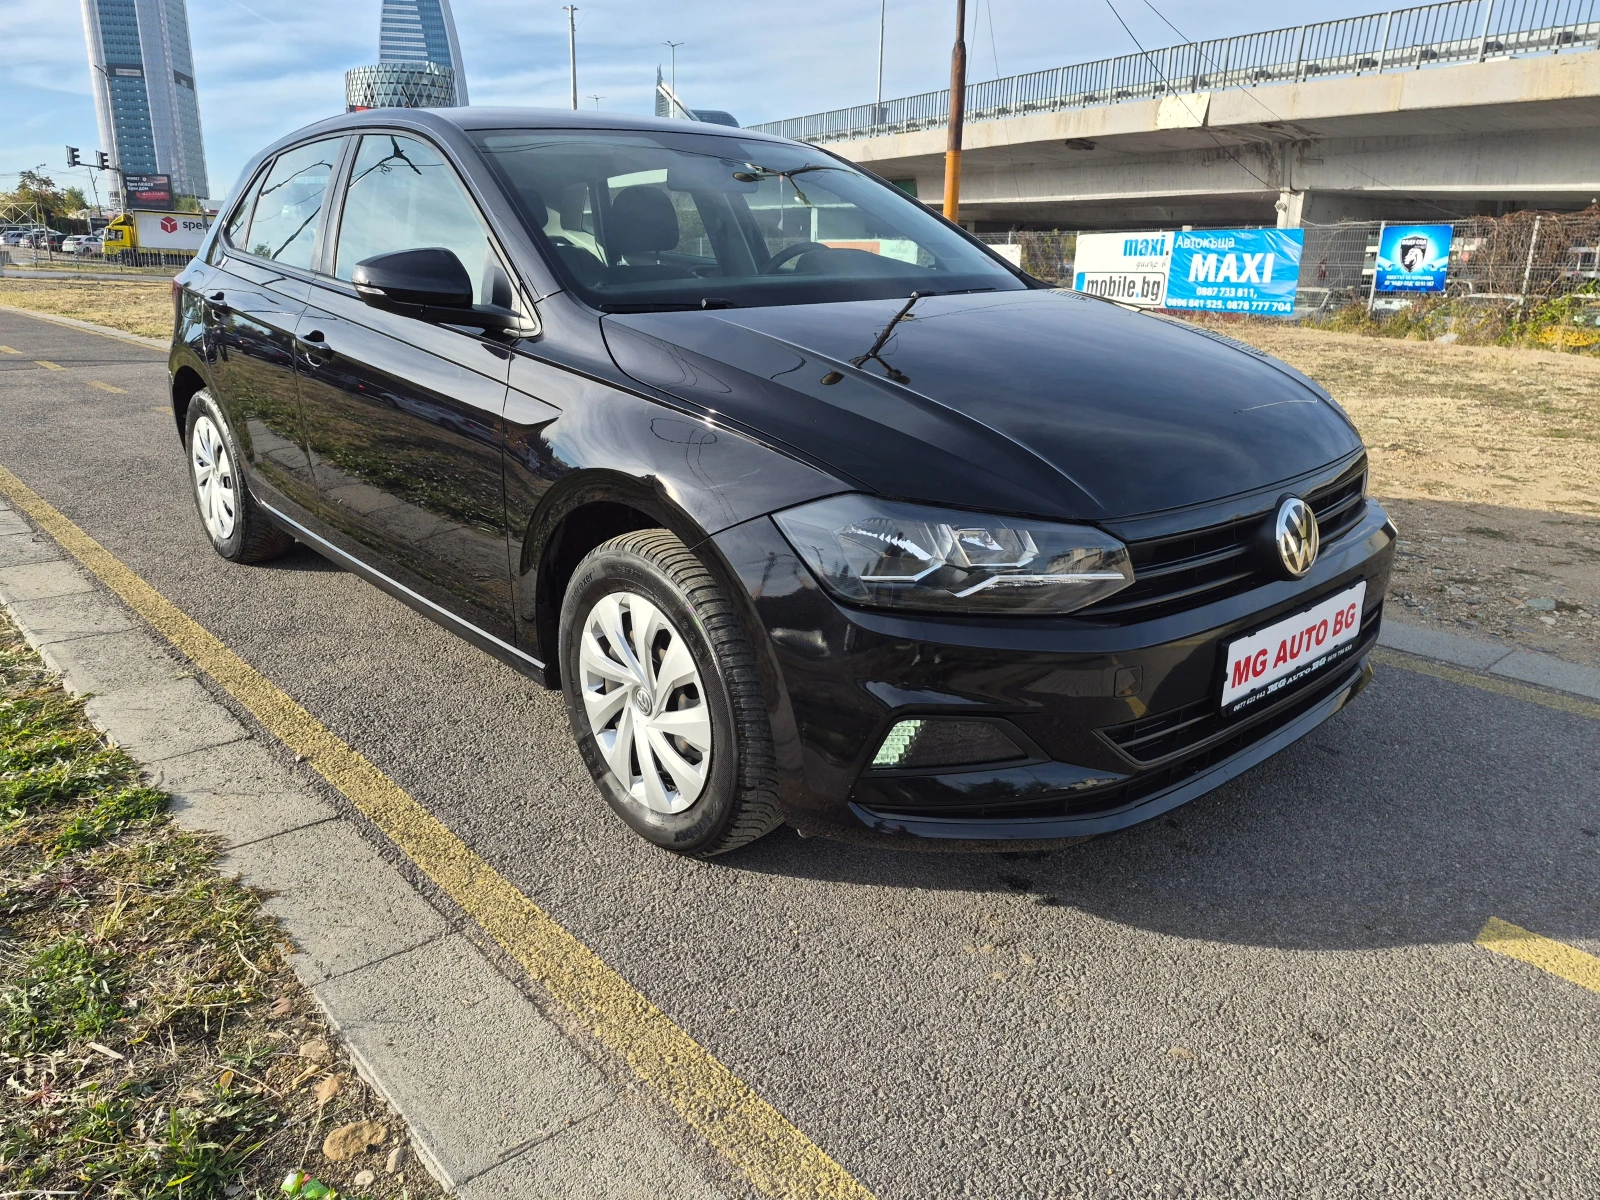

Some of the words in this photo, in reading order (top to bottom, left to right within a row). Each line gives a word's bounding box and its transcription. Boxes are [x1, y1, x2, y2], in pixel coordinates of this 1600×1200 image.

[1175, 235, 1236, 250] Автокъща
[1188, 252, 1275, 283] MAXI
[1086, 275, 1161, 301] mobile.bg
[1196, 287, 1217, 296] 0887
[1220, 287, 1235, 297] 733
[1226, 300, 1249, 310] 0878
[1251, 301, 1271, 311] 777
[1272, 302, 1291, 312] 704
[1231, 648, 1268, 689] MG
[1272, 618, 1328, 669] AUTO
[1332, 602, 1357, 637] BG
